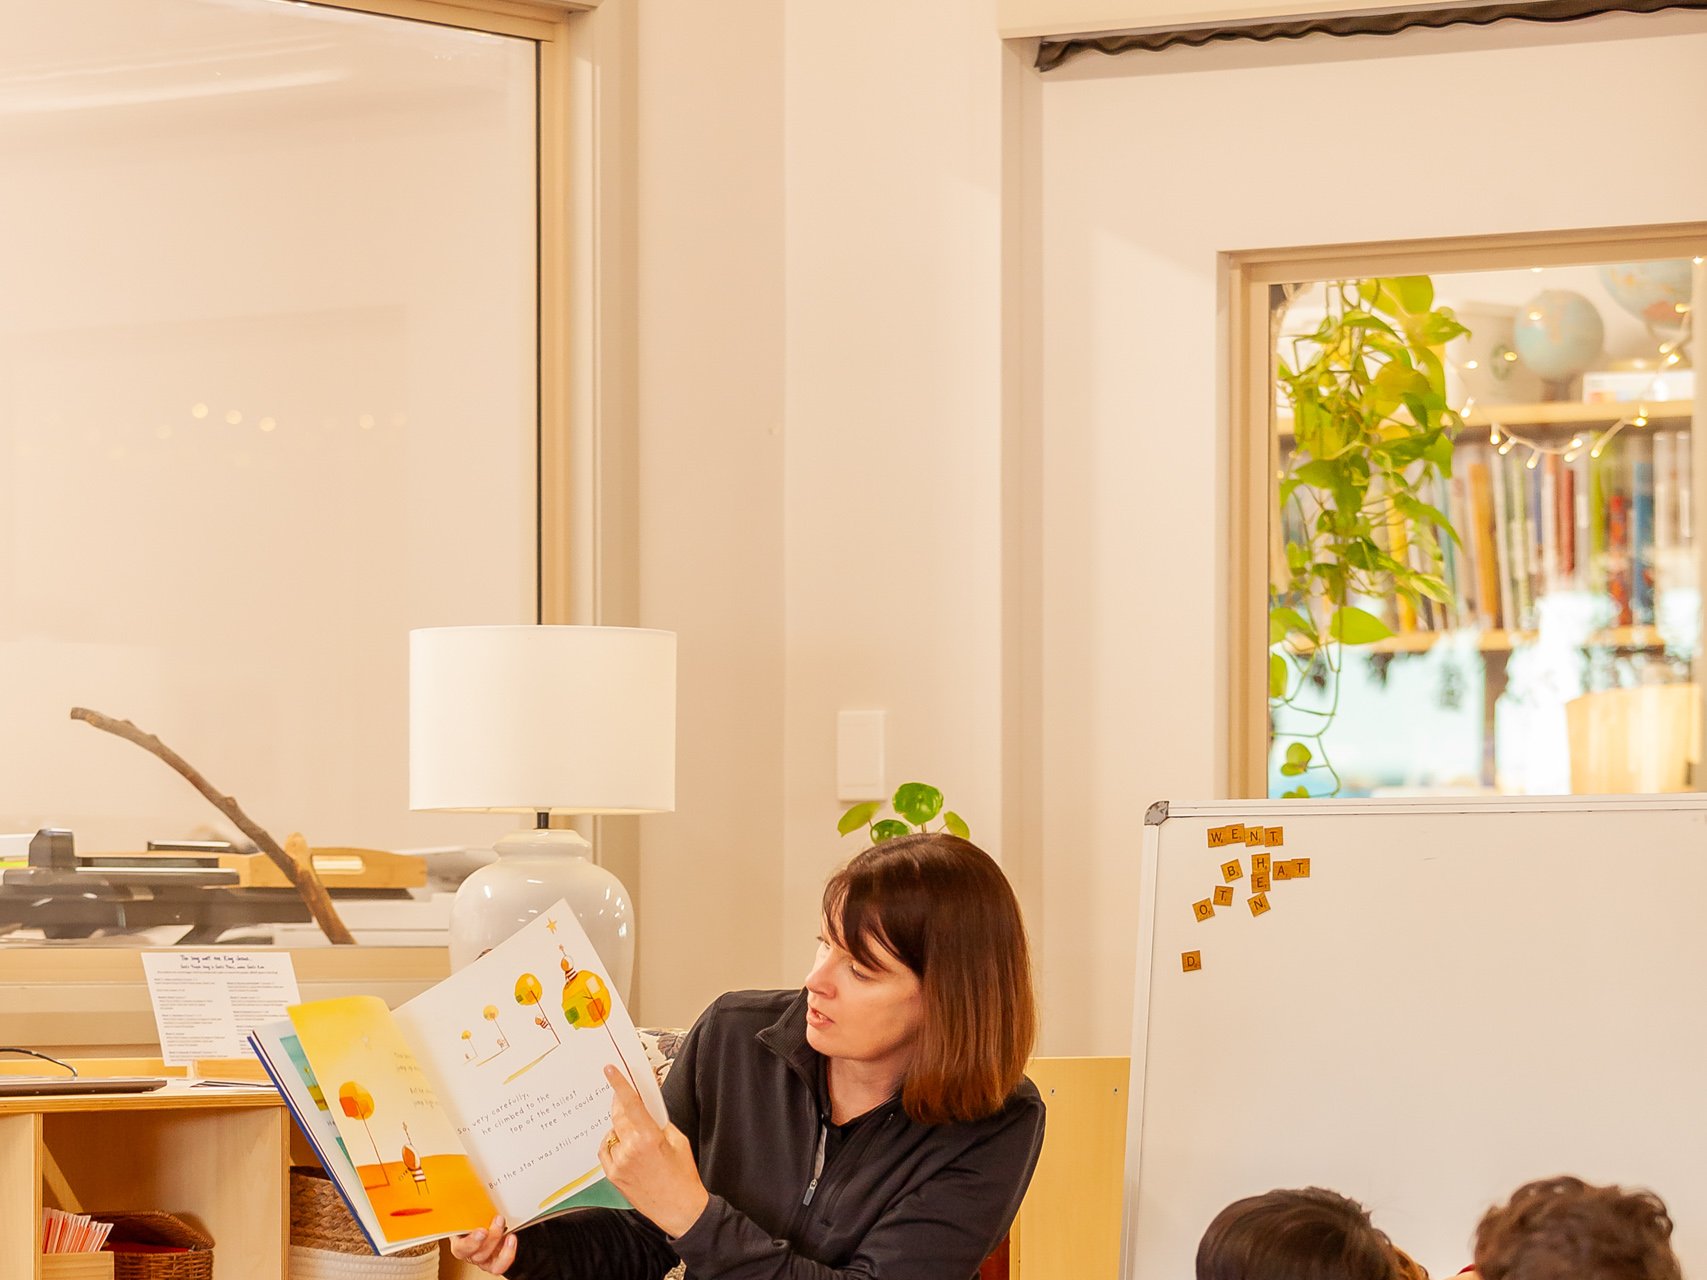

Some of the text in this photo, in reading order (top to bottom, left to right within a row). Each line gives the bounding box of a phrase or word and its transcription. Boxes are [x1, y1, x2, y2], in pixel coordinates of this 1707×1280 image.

[1209, 827, 1279, 844] WENT
[472, 1114, 489, 1127] very
[491, 1093, 529, 1116] carefully,
[481, 1093, 550, 1136] he climbed to the
[510, 1090, 577, 1134] top of the tallest
[540, 1083, 610, 1130] tree he could find
[488, 1111, 611, 1190] But the star was still way out of
